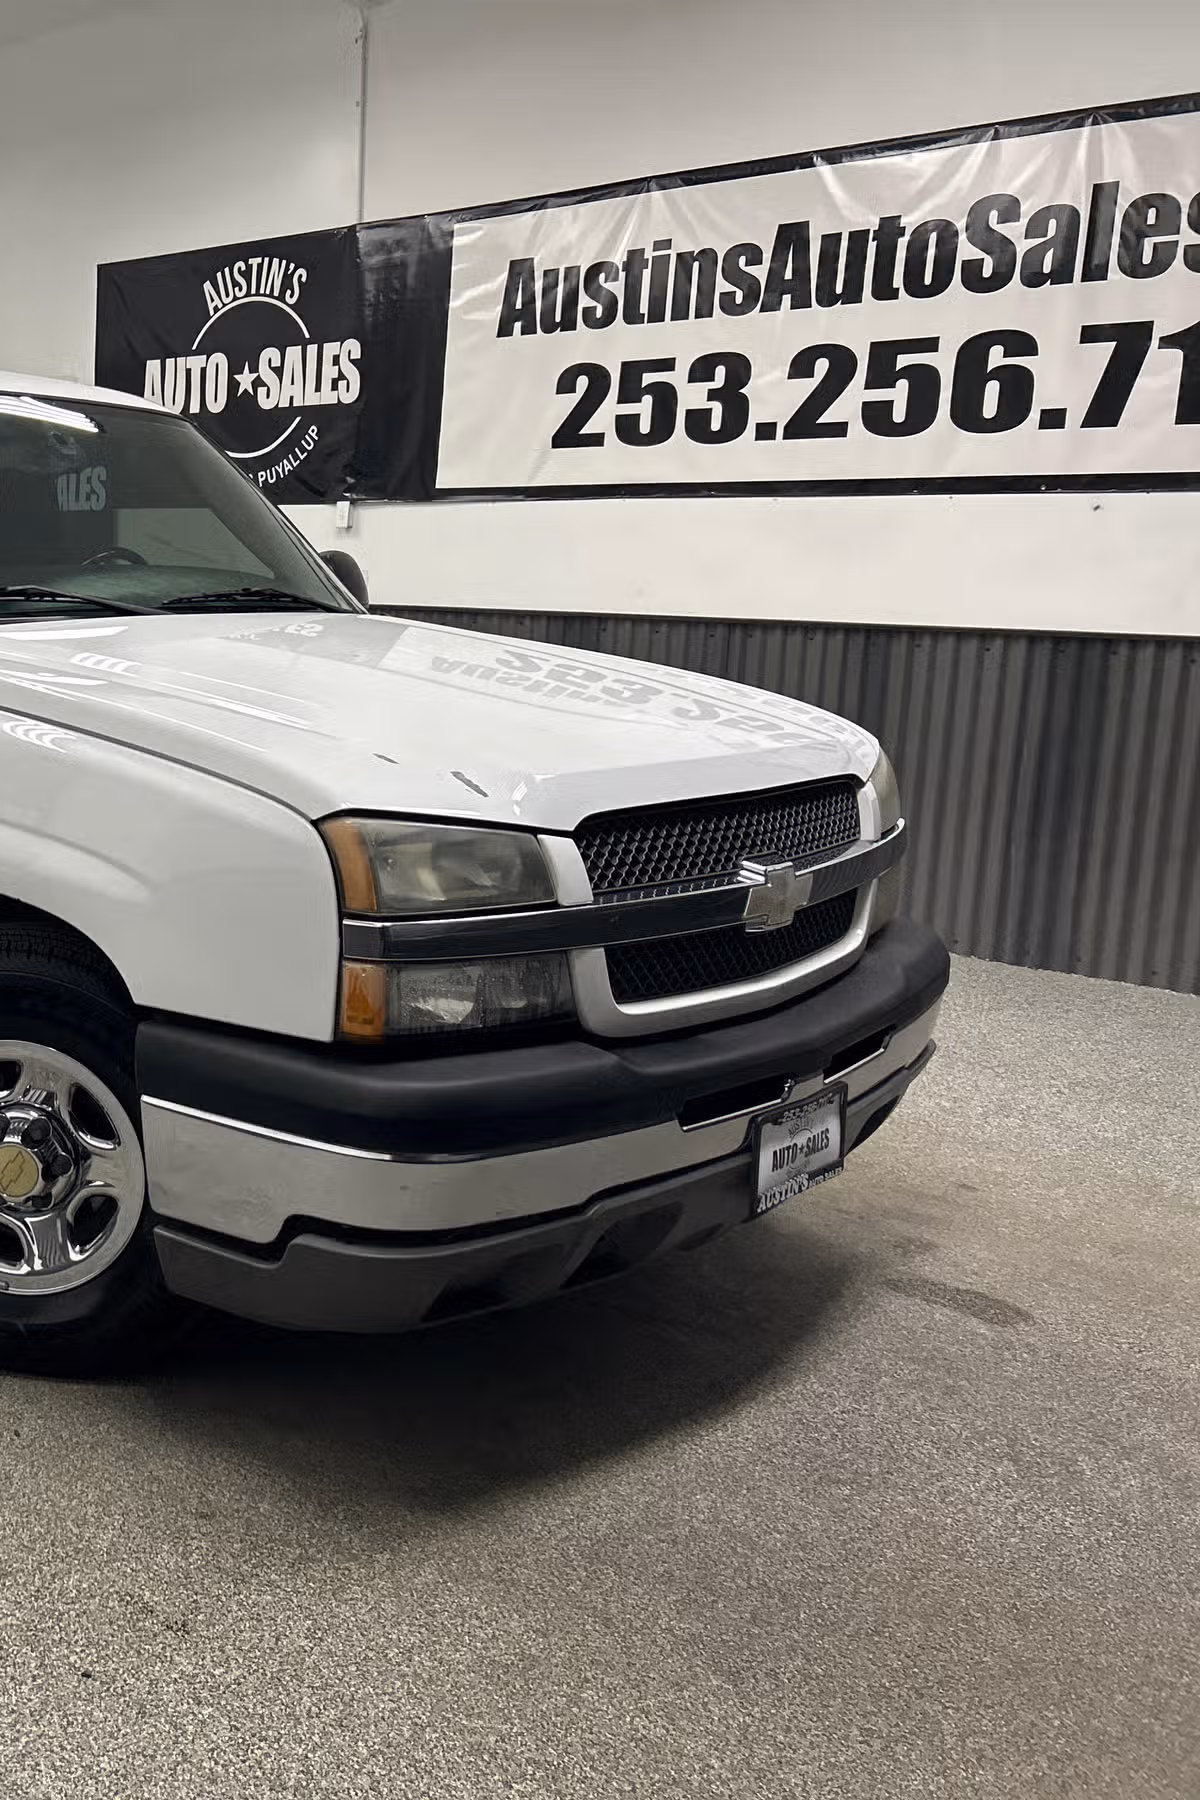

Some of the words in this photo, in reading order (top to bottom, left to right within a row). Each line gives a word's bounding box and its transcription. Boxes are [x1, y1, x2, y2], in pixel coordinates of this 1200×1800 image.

[203, 257, 307, 316] AUSTIN'S
[144, 353, 228, 413] AUTO
[257, 339, 361, 409] SALES
[551, 320, 1200, 449] 253.256.71
[258, 425, 318, 487] PUYALLUP
[772, 1143, 798, 1172] AUTO
[804, 1128, 830, 1158] SALES
